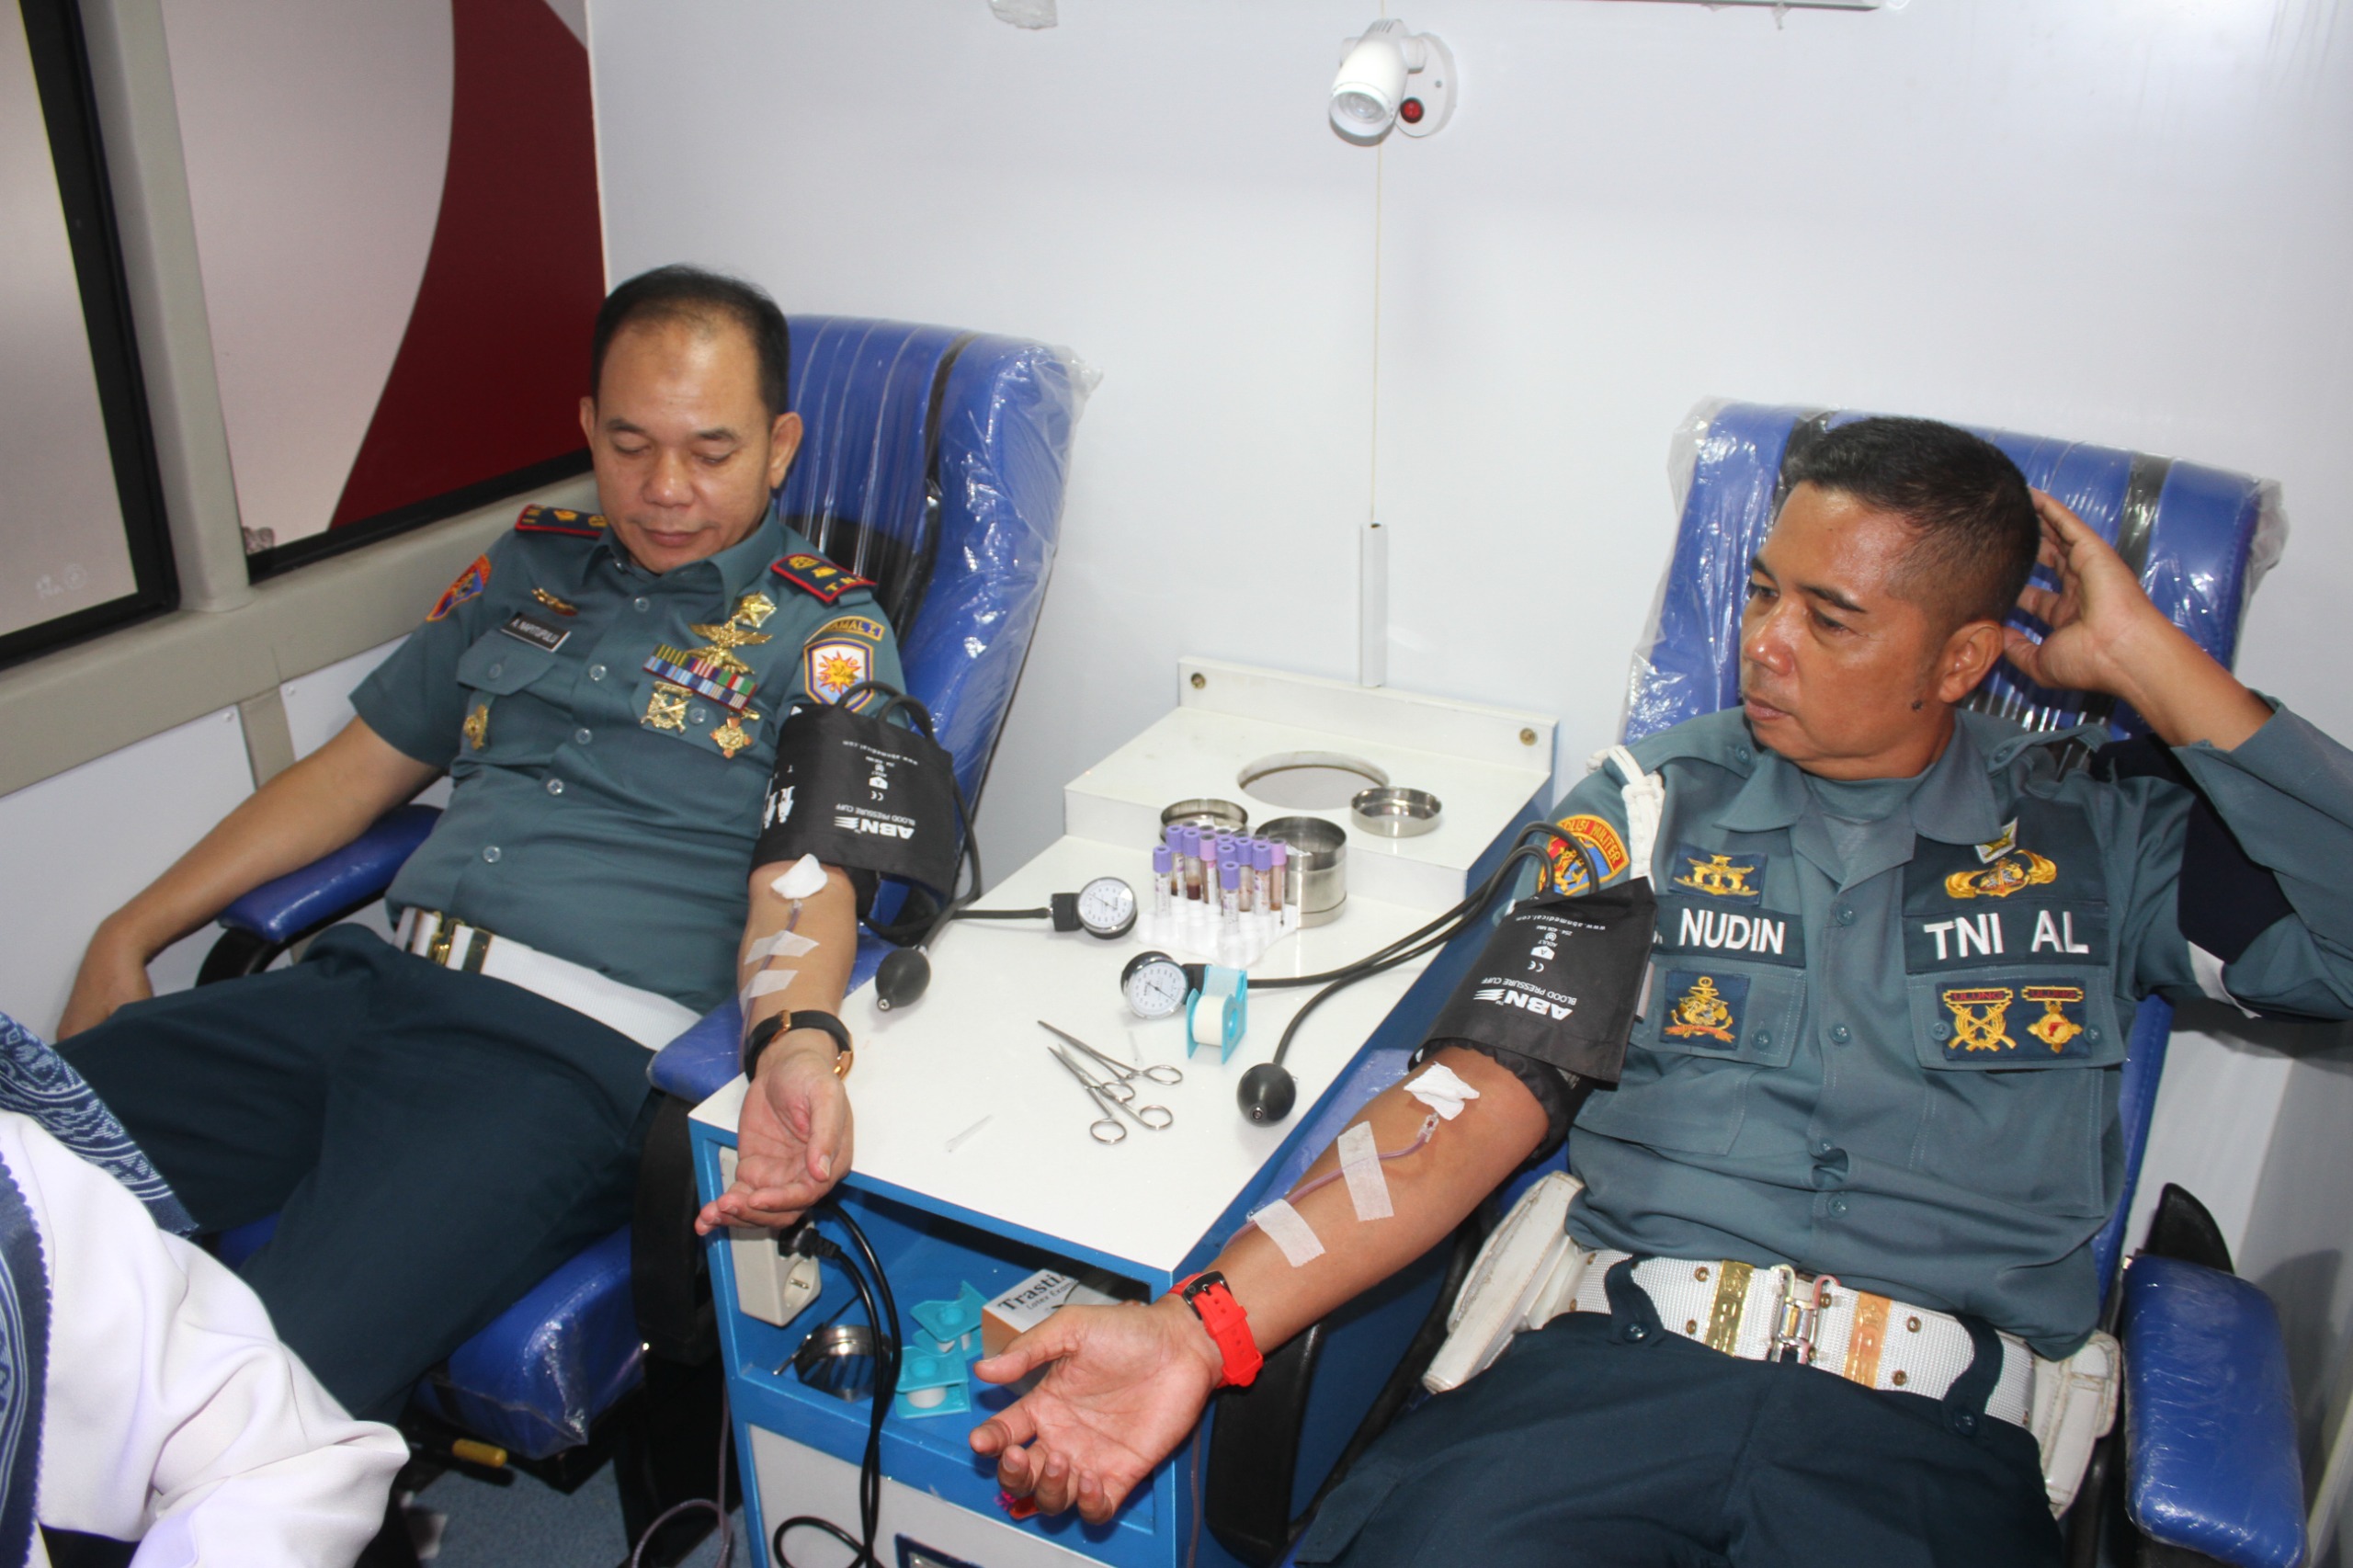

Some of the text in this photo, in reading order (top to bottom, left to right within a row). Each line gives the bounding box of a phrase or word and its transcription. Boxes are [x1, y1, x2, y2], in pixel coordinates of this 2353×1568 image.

[835, 803, 916, 827] BLOOD PRESSURE CUFF
[860, 818, 915, 840] ABN
[1515, 915, 1607, 931] www.abnmedical.com
[1677, 907, 1786, 955] NUDIN
[1538, 939, 1558, 948] ADULT
[1923, 909, 2090, 960] TNI AL
[1501, 977, 1547, 996] PRESSURE
[1952, 990, 2005, 1001] ULUNG
[1503, 989, 1574, 1021] ABN
[1546, 990, 1578, 1006] BLOOD
